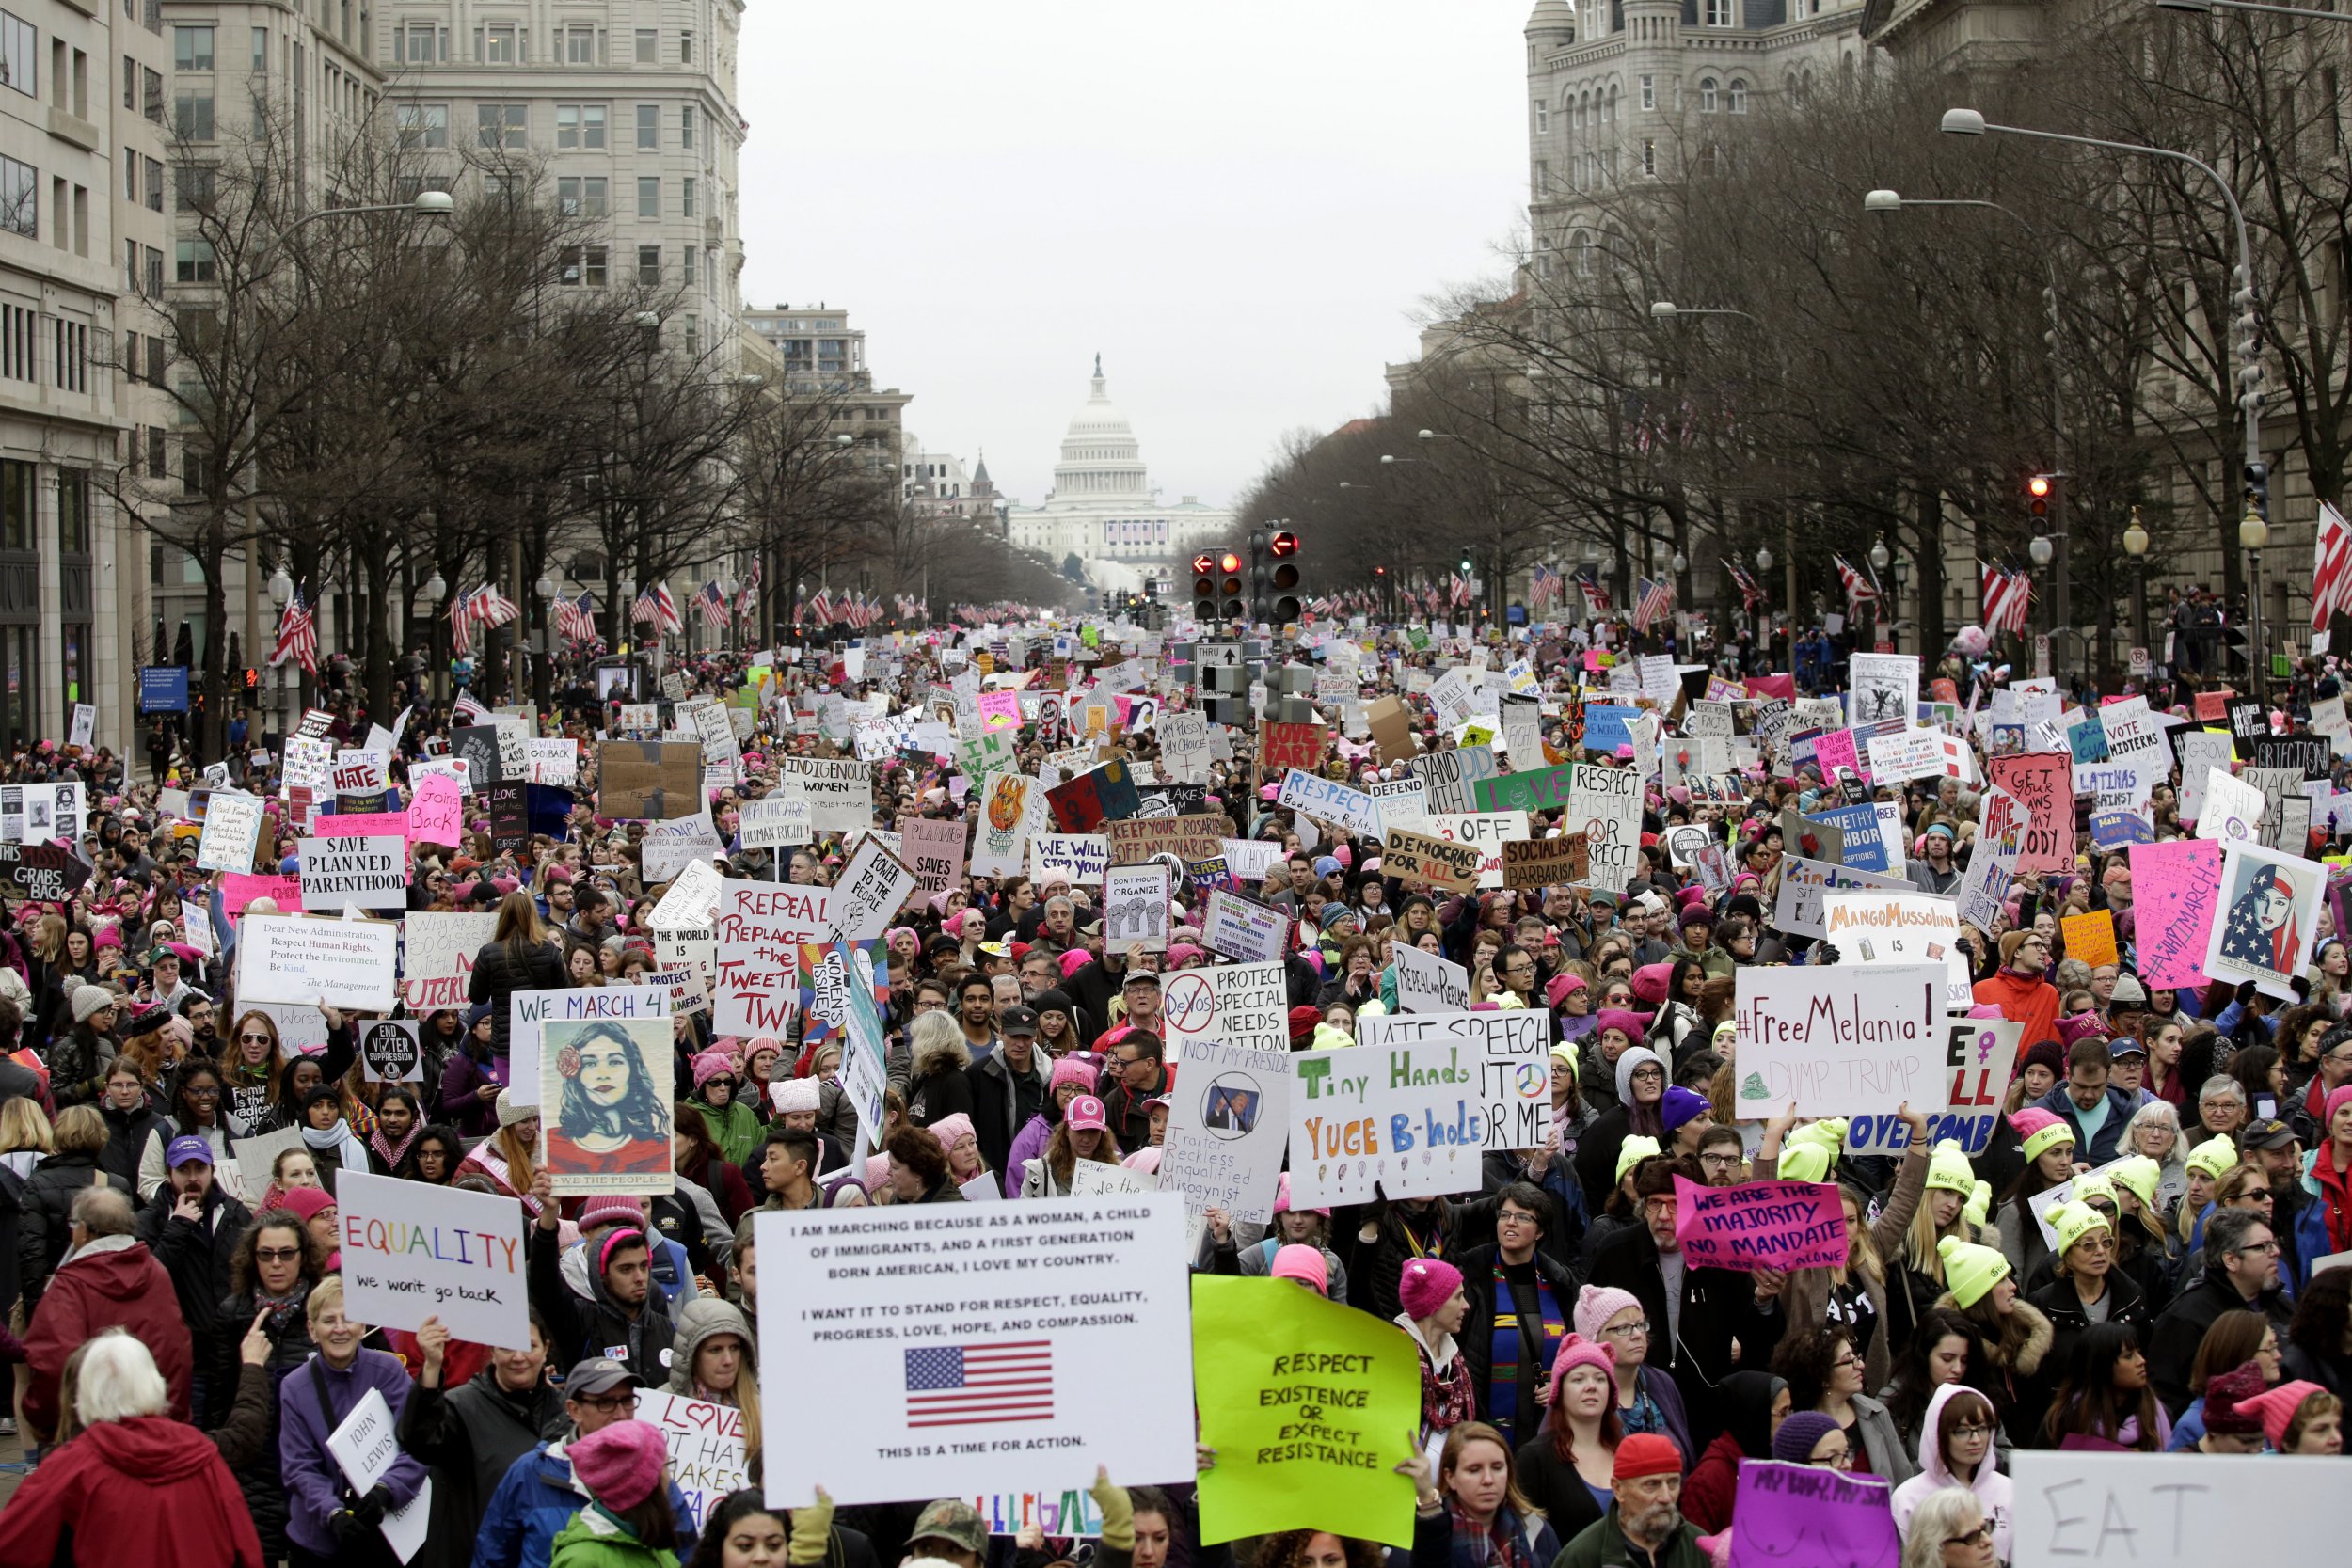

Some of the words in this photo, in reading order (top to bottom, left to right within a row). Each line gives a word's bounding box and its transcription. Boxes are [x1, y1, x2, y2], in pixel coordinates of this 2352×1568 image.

[1198, 647, 1219, 657] THRU
[1107, 661, 1127, 675] SCIENCE
[1438, 683, 1464, 705] BULLY
[1803, 704, 1839, 714] FEMINISM
[1701, 717, 1727, 731] FACTS
[1788, 714, 1820, 727] MAKE
[2106, 721, 2139, 740] VOTE
[298, 726, 323, 737] ARMY
[1265, 721, 1320, 744] LOVE
[1508, 724, 1536, 746] FIGHT
[531, 750, 545, 759] GO
[548, 750, 570, 759] BACK
[962, 734, 1000, 759] IN
[1178, 738, 1206, 752] CHOICE
[2109, 733, 2158, 757] MIDTERMS
[2187, 741, 2231, 759] GROW
[342, 754, 358, 765] DO
[359, 753, 378, 764] THE
[332, 764, 380, 790] HATE
[786, 758, 871, 782] INDIGENOUS
[2011, 769, 2053, 788] GET
[2080, 769, 2137, 790] LATINAS
[803, 780, 850, 792] WOMEN
[1373, 780, 1422, 797] DEFEND
[1577, 766, 1640, 796] RESPECT
[2014, 783, 2053, 799] YOUR
[2246, 769, 2304, 795] BLACK
[420, 781, 458, 814] Going
[493, 788, 518, 800] LOVE
[1287, 771, 1373, 816] RESPECT
[215, 801, 230, 813] Paid
[231, 805, 253, 818] Family
[411, 806, 453, 832] Back
[742, 798, 809, 822] HEALTHCARE
[1283, 793, 1313, 812] Body
[1319, 810, 1338, 820] my
[1342, 813, 1374, 832] Rights
[1985, 794, 2014, 839] HATE
[743, 827, 774, 844] HUMAN
[910, 822, 960, 842] PLANNED
[1113, 820, 1146, 840] KEEP
[1148, 818, 1178, 836] YOUR
[1460, 818, 1511, 842] OFF
[204, 842, 226, 853] Equal
[327, 836, 369, 853] SAVE
[673, 838, 686, 847] GOT
[1037, 840, 1065, 856] WE
[1070, 839, 1105, 857] WILL
[1116, 841, 1144, 863] OFF
[1145, 838, 1163, 856] MY
[1167, 838, 1220, 859] OVARIES
[1506, 838, 1576, 863] SOCIALISM
[1576, 833, 1587, 847] OR
[1675, 839, 1705, 851] FEMINISM
[308, 855, 391, 873] PLANNED
[915, 853, 949, 873] SAVES
[1074, 858, 1103, 879] YOU
[1384, 852, 1419, 874] FOR
[1420, 861, 1455, 883] ALL
[14, 867, 63, 885] GRABS
[302, 874, 405, 894] PARENTHOOD
[863, 868, 875, 885] TO
[874, 880, 891, 901] THE
[1508, 862, 1575, 887] BARBARISM
[30, 883, 66, 900] BACK
[1113, 885, 1160, 896] ORGANIZE
[1797, 886, 1816, 899] Sit
[734, 889, 828, 922] REPEAL
[263, 924, 285, 934] Dear
[288, 926, 308, 935] New
[310, 927, 380, 941] Administration,
[657, 931, 671, 942] THE
[676, 930, 709, 941] WORLD
[721, 913, 815, 945] REPLACE
[271, 937, 306, 948] Respect
[309, 940, 341, 950] Human
[342, 942, 373, 954] Rights.
[676, 945, 686, 957] IS
[1892, 940, 1903, 952] IS
[270, 950, 303, 960] Protect
[305, 952, 320, 961] the
[322, 953, 381, 966] Environment.
[753, 946, 796, 968] the
[269, 962, 281, 972] Be
[283, 963, 308, 974] Kind.
[649, 969, 691, 985] PROTECT
[1217, 967, 1286, 990] PROTECT
[2226, 958, 2239, 967] WE
[2240, 962, 2256, 972] THE
[2257, 967, 2285, 981] PEOPLE
[324, 979, 380, 992] Management
[1396, 949, 1432, 993] REPEAL
[1431, 983, 1440, 995] AND
[1438, 965, 1469, 1011] REPLACE
[566, 994, 634, 1020] MARCH
[645, 992, 662, 1017] 4
[1167, 990, 1212, 1016] DeVos
[1214, 990, 1286, 1012] SPECIAL
[280, 1006, 321, 1025] Worst
[1222, 1012, 1279, 1033] NEEDS
[1737, 983, 1932, 1045] #FreeMelania!
[379, 1025, 397, 1037] END
[369, 1052, 414, 1062] SUPPRESSION
[1184, 1041, 1220, 1063] NOT
[1222, 1048, 1241, 1066] MY
[1297, 1056, 1369, 1104] Tiny
[1390, 1046, 1470, 1089] Hands
[1770, 1060, 1829, 1101] DUMP
[1836, 1055, 1920, 1099] TRUMP
[234, 1098, 246, 1108] is
[247, 1095, 266, 1106] the
[1168, 1126, 1225, 1151] Traitor
[1304, 1117, 1378, 1160] YUGE
[2041, 1129, 2058, 1142] Girl
[1164, 1142, 1234, 1167] Reckless
[1078, 1160, 1108, 1173] Consider
[612, 1176, 657, 1184] PEOPLE
[1933, 1172, 1953, 1184] Girl
[2113, 1171, 2136, 1189] Gang
[1693, 1193, 1726, 1212] WE
[1730, 1186, 1774, 1206] ARE
[1776, 1184, 1822, 1198] THE
[2083, 1184, 2101, 1196] Girl
[802, 1226, 823, 1237] AM
[829, 1221, 909, 1235] MARCHING
[914, 1216, 983, 1231] BECAUSE
[989, 1215, 1009, 1227] AS
[1107, 1208, 1151, 1221] CHILD
[1702, 1201, 1820, 1233] MAJORITY
[346, 1215, 518, 1274] EQUALITY
[811, 1246, 829, 1259] OF
[942, 1240, 972, 1251] AND
[991, 1236, 1033, 1248] FIRST
[1039, 1231, 1134, 1246] GENERATION
[1686, 1238, 1717, 1254] NO
[1730, 1218, 1844, 1258] MANDATE
[1272, 1353, 1375, 1377] RESPECT
[1259, 1385, 1371, 1409] EXISTENCE
[1299, 1404, 1324, 1421] OR
[349, 1412, 378, 1451] JOHN
[1279, 1422, 1362, 1446] EXPECT
[360, 1433, 394, 1474] LEWIS
[878, 1447, 913, 1459] THIS
[917, 1446, 931, 1457] IS
[951, 1443, 986, 1454] TIME
[991, 1440, 1021, 1452] FOR
[1256, 1442, 1378, 1468] RESISTANCE
[2044, 1478, 2210, 1559] EAT
